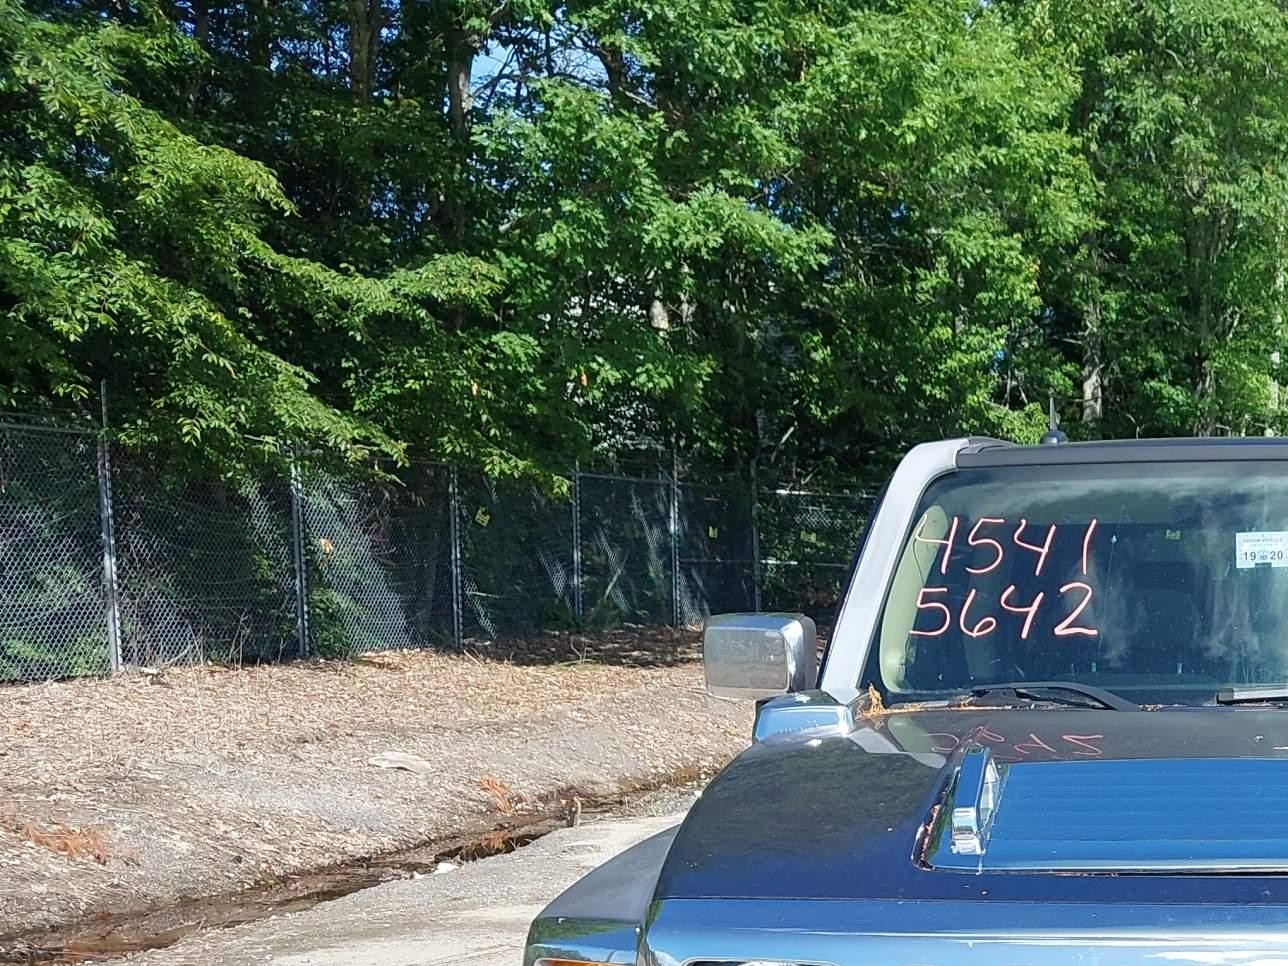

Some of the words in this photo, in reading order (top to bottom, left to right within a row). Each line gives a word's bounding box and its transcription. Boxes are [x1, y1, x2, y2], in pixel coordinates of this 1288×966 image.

[915, 514, 1097, 576] 4541
[1243, 551, 1257, 561] 19
[1270, 550, 1284, 560] 20
[908, 581, 1099, 640] 5642
